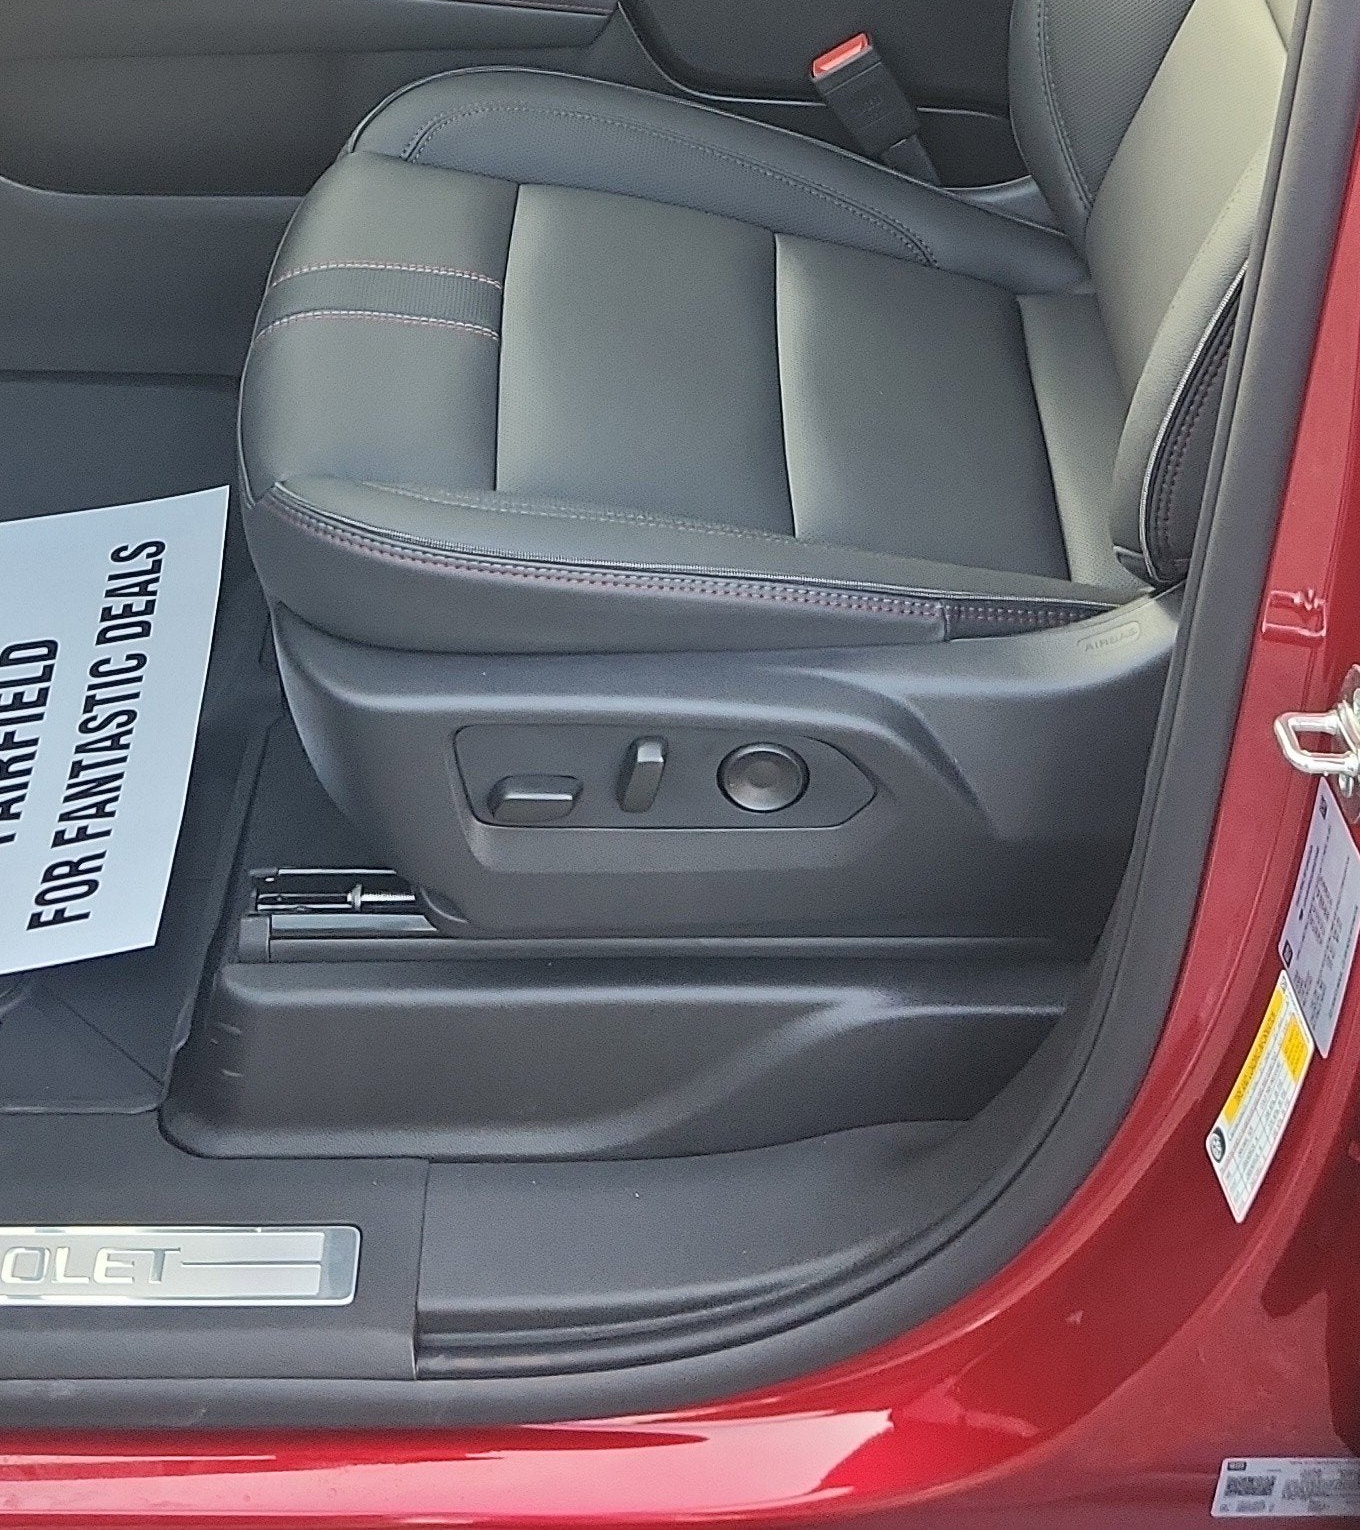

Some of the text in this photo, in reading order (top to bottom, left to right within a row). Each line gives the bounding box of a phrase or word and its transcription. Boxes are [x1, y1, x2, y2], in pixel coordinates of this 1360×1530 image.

[26, 539, 167, 931] FOR FANTASTIC DEALS
